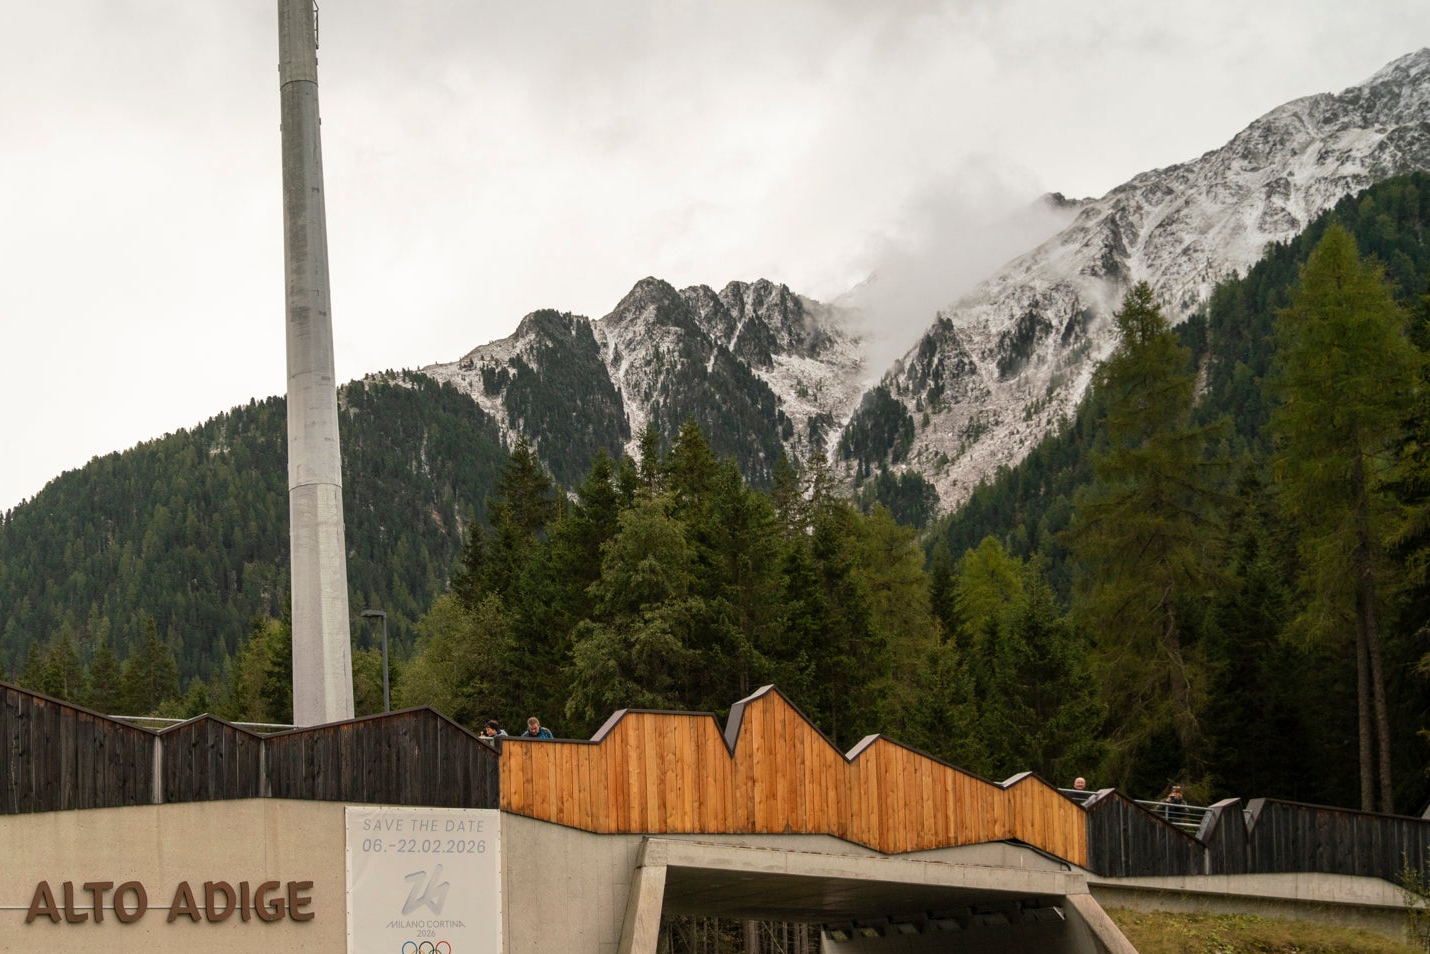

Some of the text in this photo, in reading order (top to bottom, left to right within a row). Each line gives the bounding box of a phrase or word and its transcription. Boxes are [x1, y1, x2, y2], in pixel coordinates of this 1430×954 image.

[363, 819, 484, 833] SAVE THE DATE
[26, 880, 148, 924] ALTO
[167, 880, 315, 923] ADIGE
[386, 920, 466, 929] MILANO CORTINA
[417, 929, 436, 938] 2026
